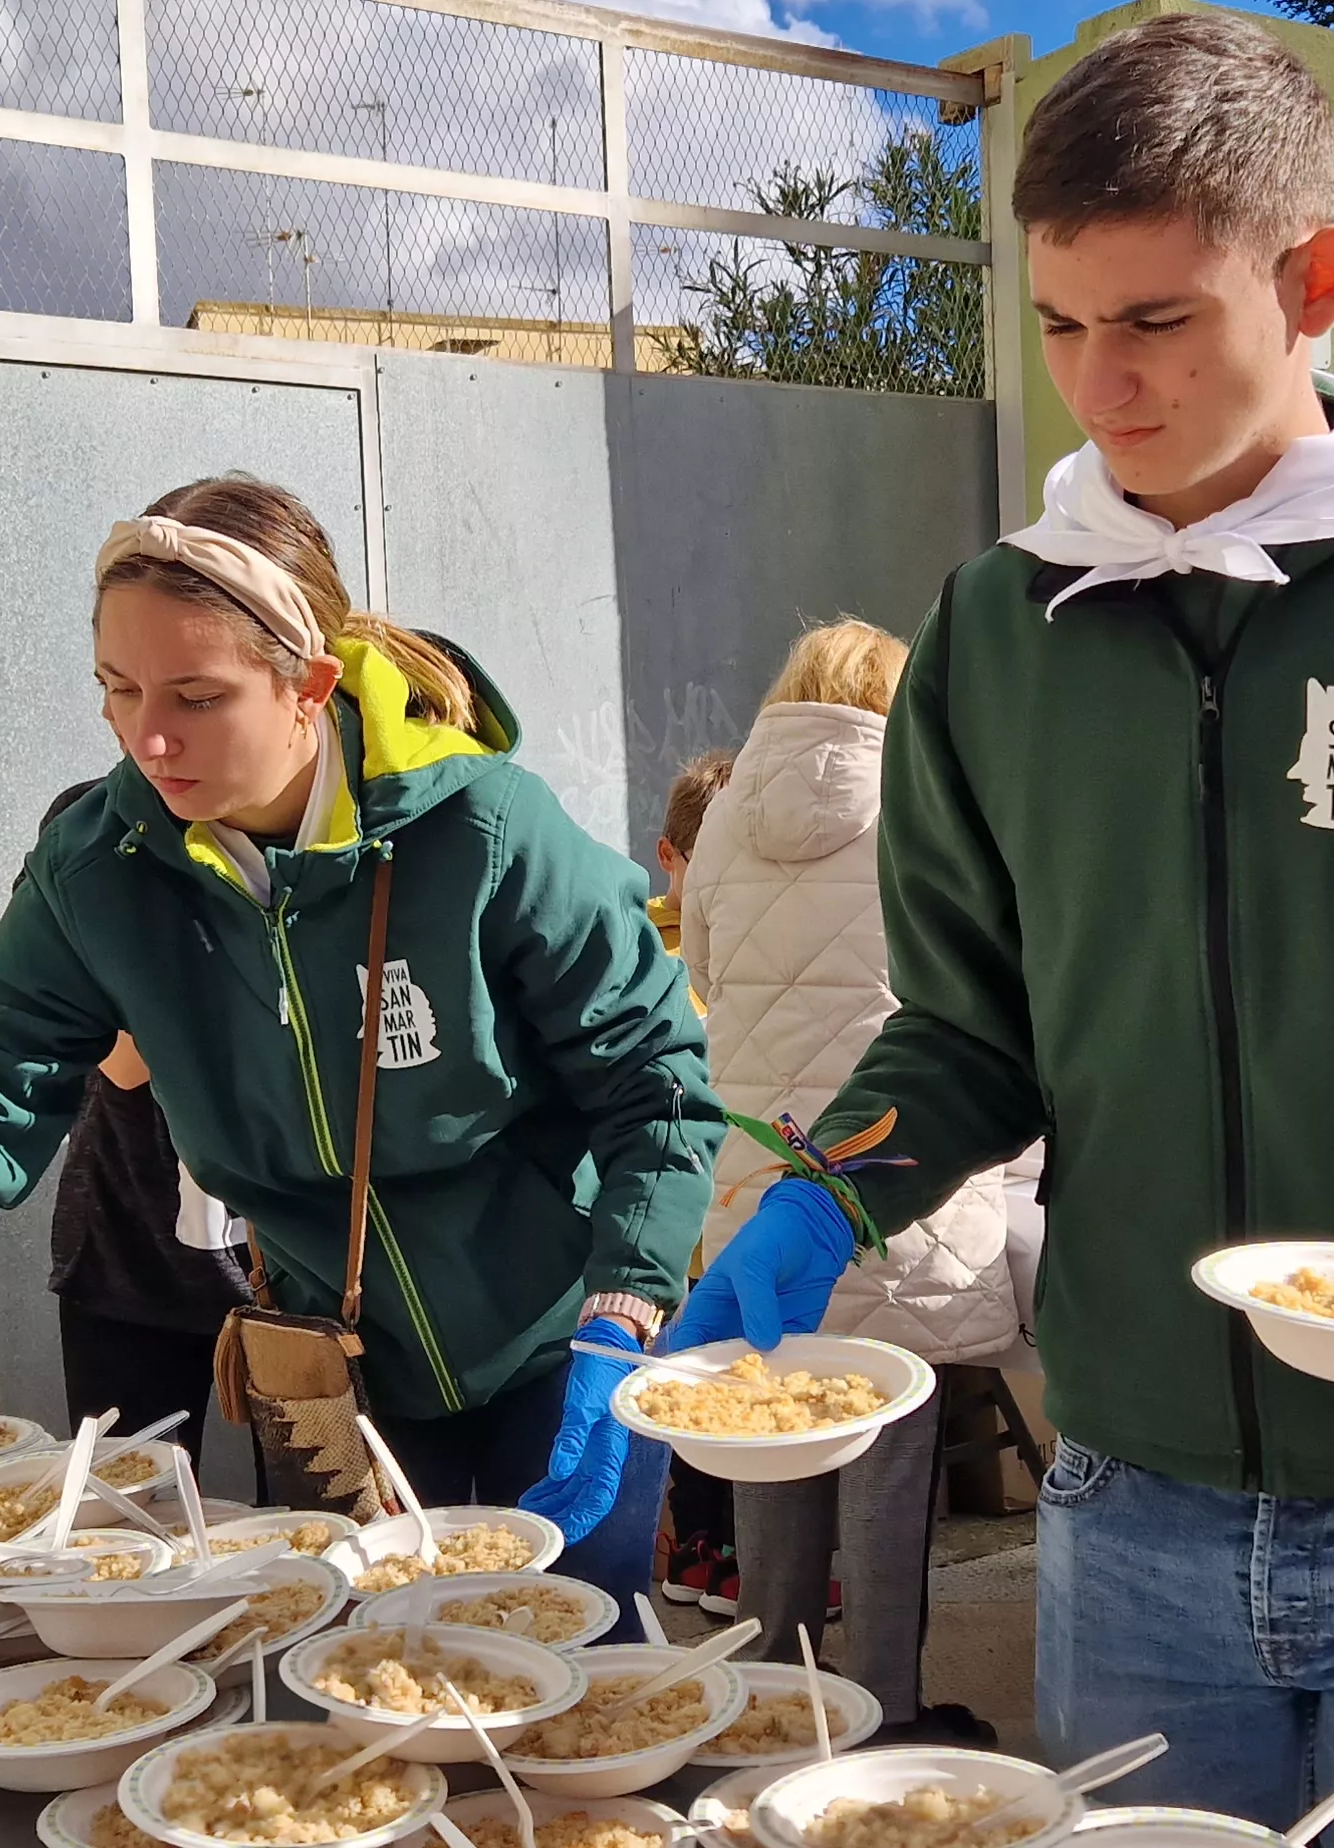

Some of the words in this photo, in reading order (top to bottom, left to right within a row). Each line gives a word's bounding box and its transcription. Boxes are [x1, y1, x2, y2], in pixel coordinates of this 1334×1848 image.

[382, 966, 408, 983] VIVA
[383, 1009, 416, 1033] MAR
[386, 1031, 423, 1062] TIN
